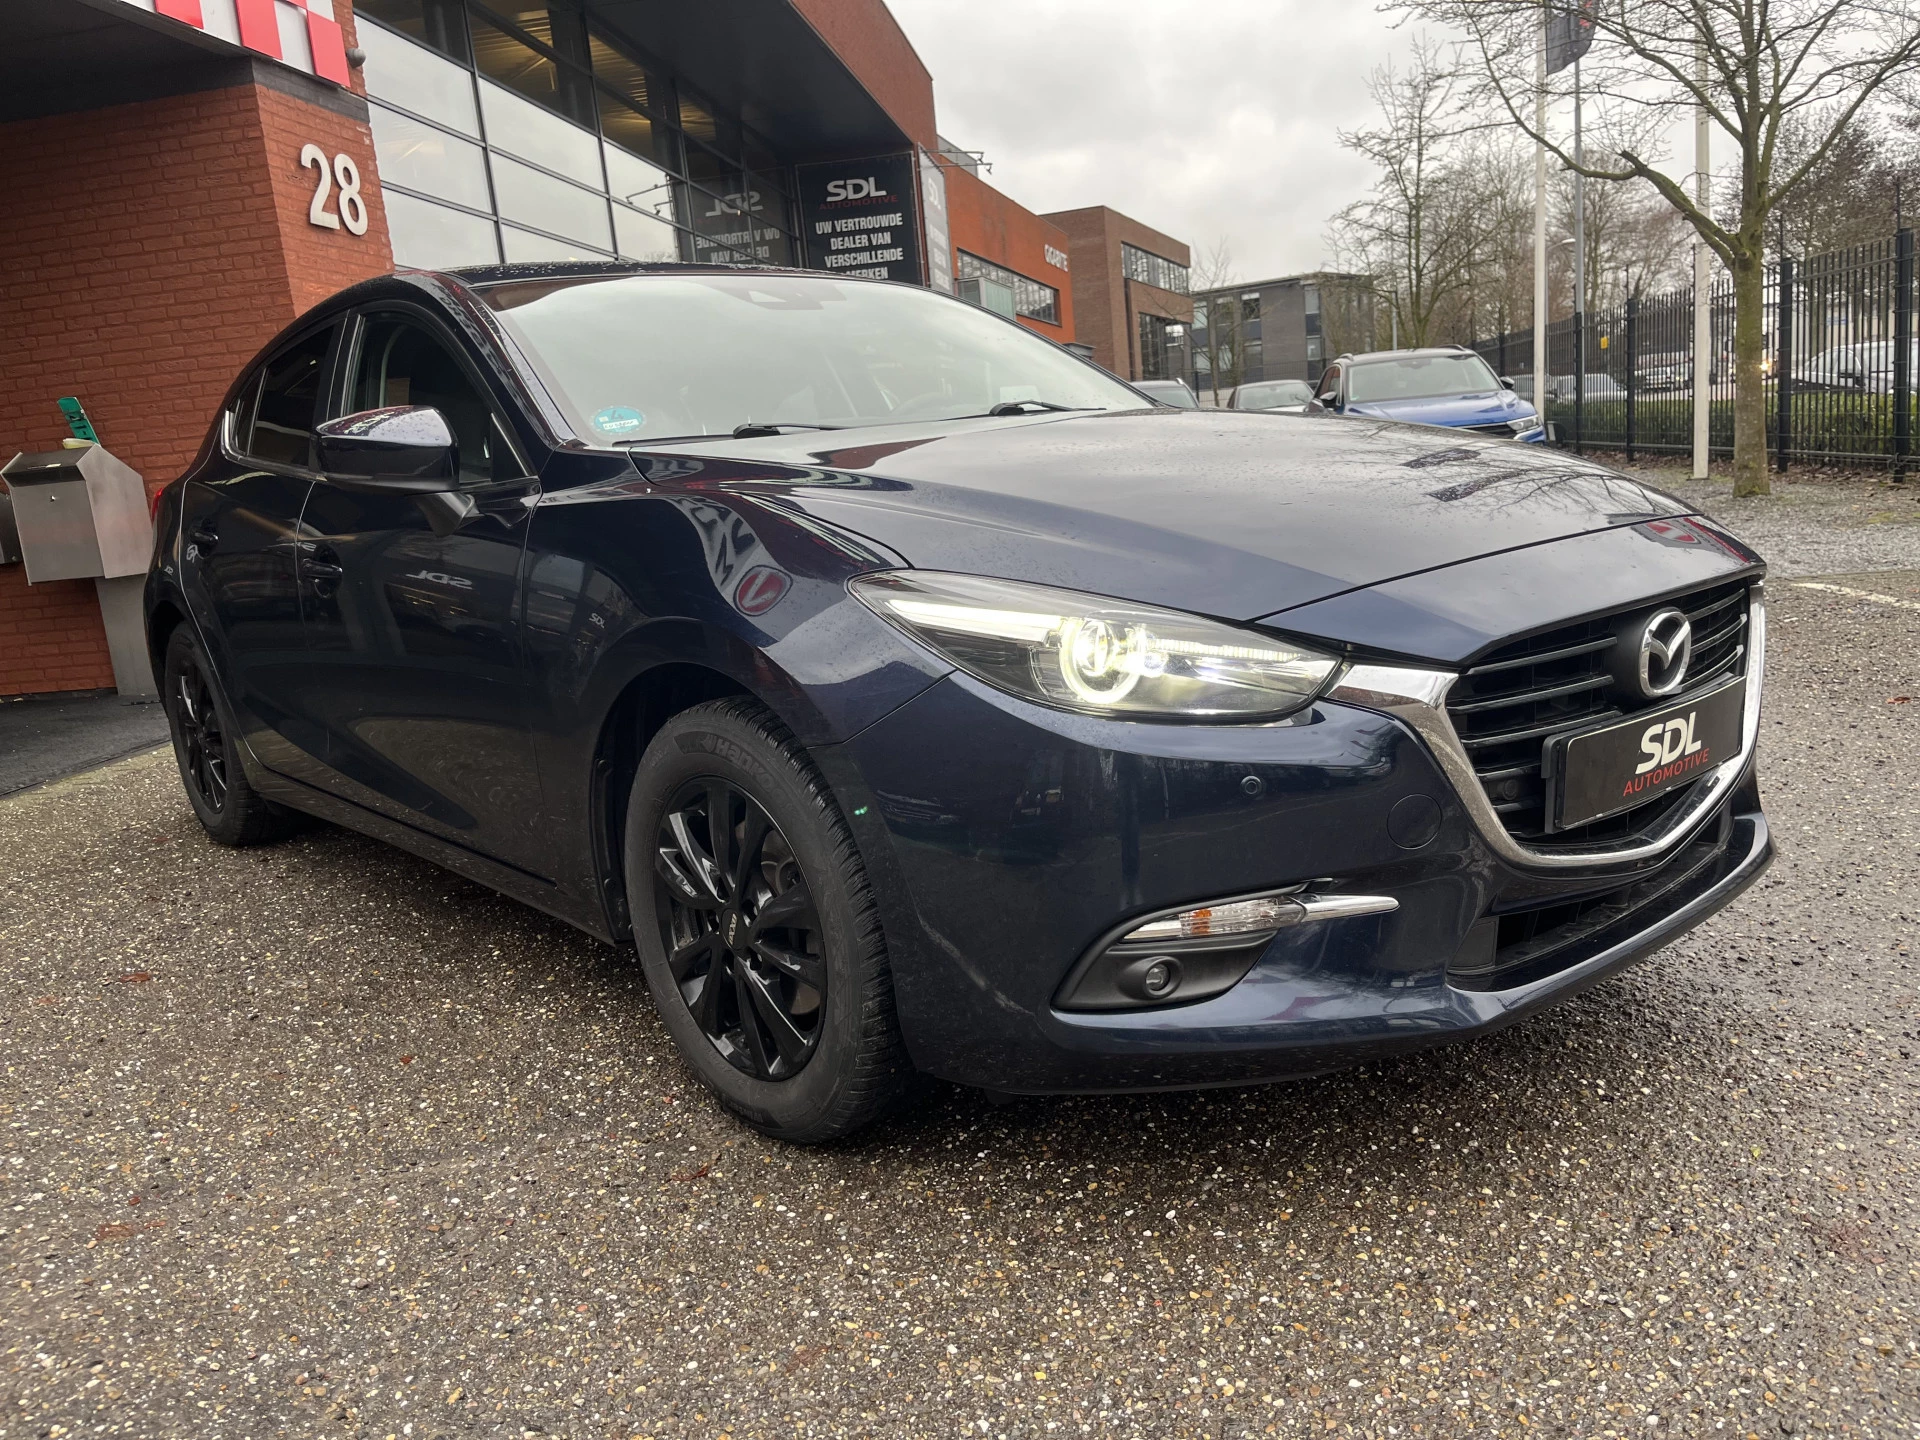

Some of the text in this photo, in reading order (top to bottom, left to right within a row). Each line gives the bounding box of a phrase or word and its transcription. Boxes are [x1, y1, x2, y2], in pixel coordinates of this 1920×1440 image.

[301, 143, 369, 236] 28
[826, 176, 887, 202] SDL
[819, 194, 899, 210] AUTOMOTIVE
[815, 212, 904, 235] UW VERTROUWDE
[830, 231, 892, 250] DEALER VAN
[824, 247, 904, 268] VERSCHILLENDE
[1635, 711, 1702, 775] SDL
[1622, 748, 1710, 797] AUTOMOTIVE
